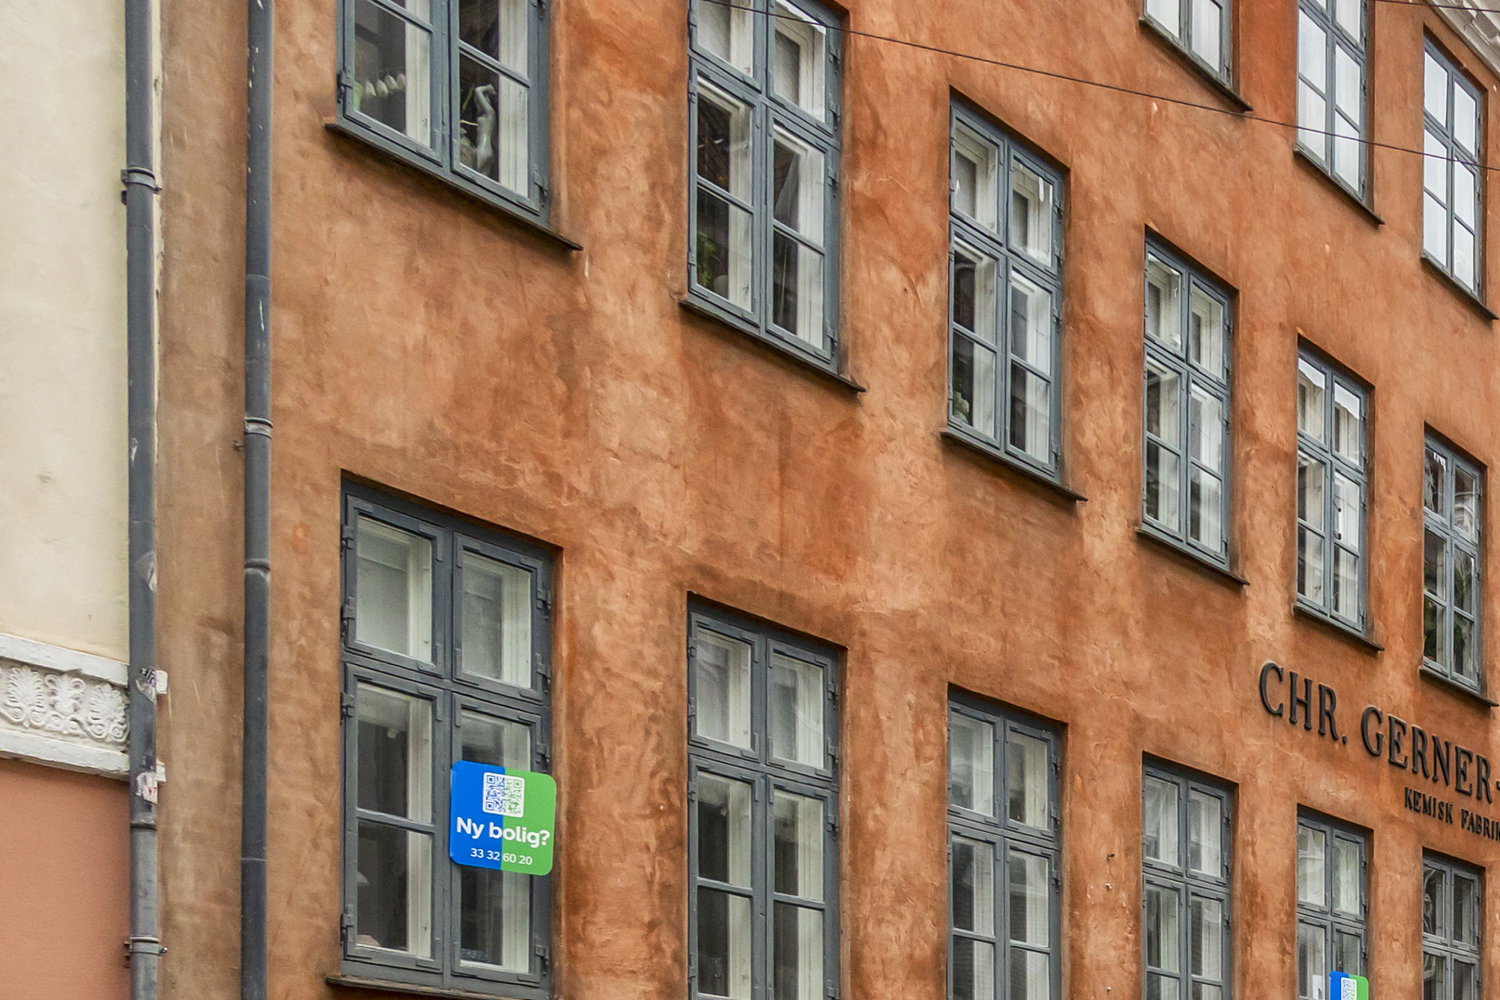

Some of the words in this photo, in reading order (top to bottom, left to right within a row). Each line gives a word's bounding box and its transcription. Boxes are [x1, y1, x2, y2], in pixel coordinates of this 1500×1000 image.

[1259, 662, 1348, 745] CHR.
[1404, 787, 1453, 824] KEMISK
[456, 817, 484, 839] Ny
[489, 822, 550, 848] bolig?
[470, 848, 484, 858] 33
[487, 850, 500, 861] 32
[502, 853, 517, 863] 60
[519, 855, 533, 865] 20
